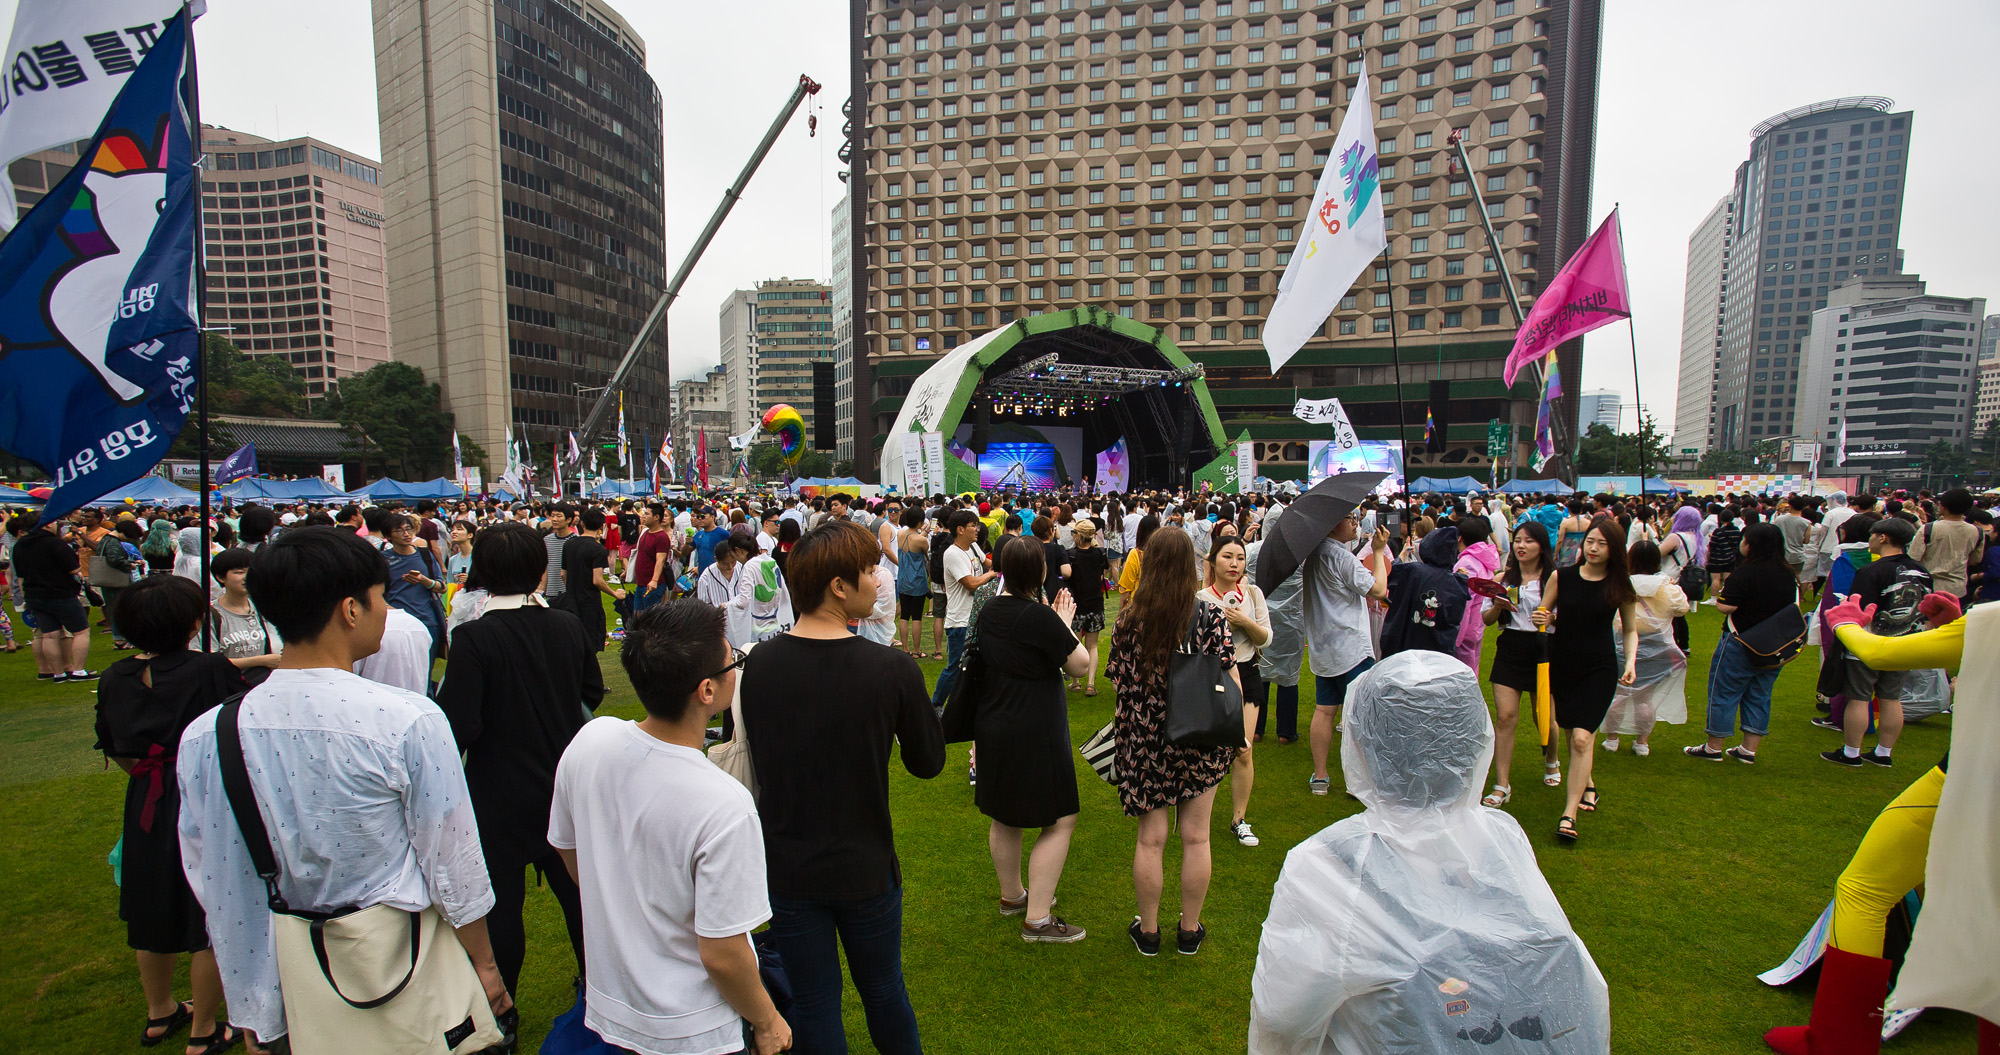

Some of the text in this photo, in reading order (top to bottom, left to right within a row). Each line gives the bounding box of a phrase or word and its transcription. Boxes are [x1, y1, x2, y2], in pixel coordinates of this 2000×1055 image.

[338, 200, 385, 222] THE WESTIN
[346, 212, 381, 229] CHOSUN
